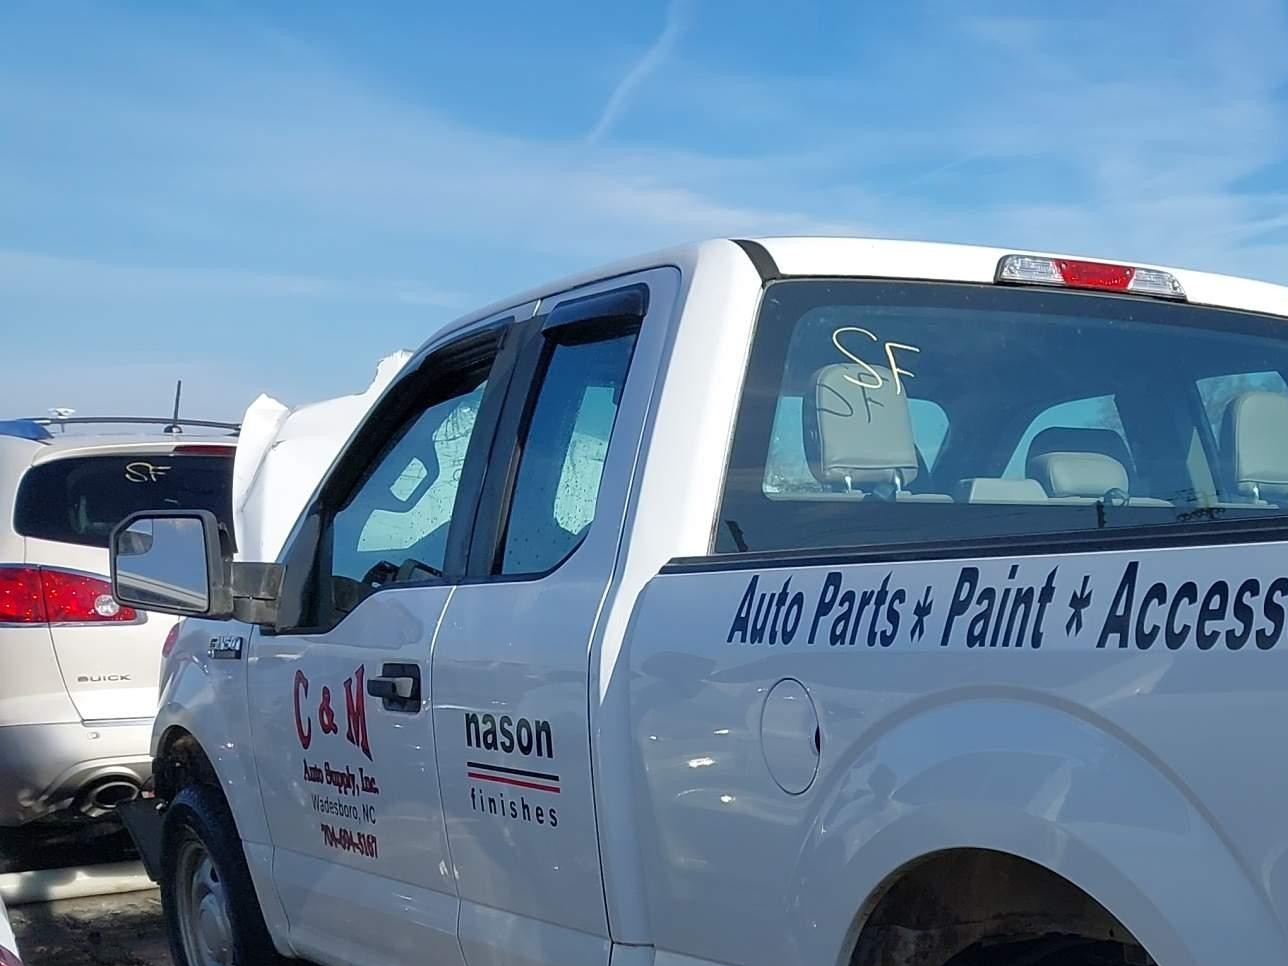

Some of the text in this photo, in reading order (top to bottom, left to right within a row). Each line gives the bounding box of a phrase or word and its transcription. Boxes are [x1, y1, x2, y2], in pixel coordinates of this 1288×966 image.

[832, 326, 920, 396] SF
[125, 462, 172, 482] SF
[727, 574, 805, 646] Auto
[807, 571, 906, 648] Parts
[941, 564, 1060, 649] Paint
[77, 674, 132, 682] BUICK
[293, 663, 373, 761] C & M
[464, 712, 554, 759] nason
[303, 758, 379, 797] Auto Supply, Inc.
[311, 793, 377, 824] Wadesboro, NC
[470, 787, 558, 827] finishes
